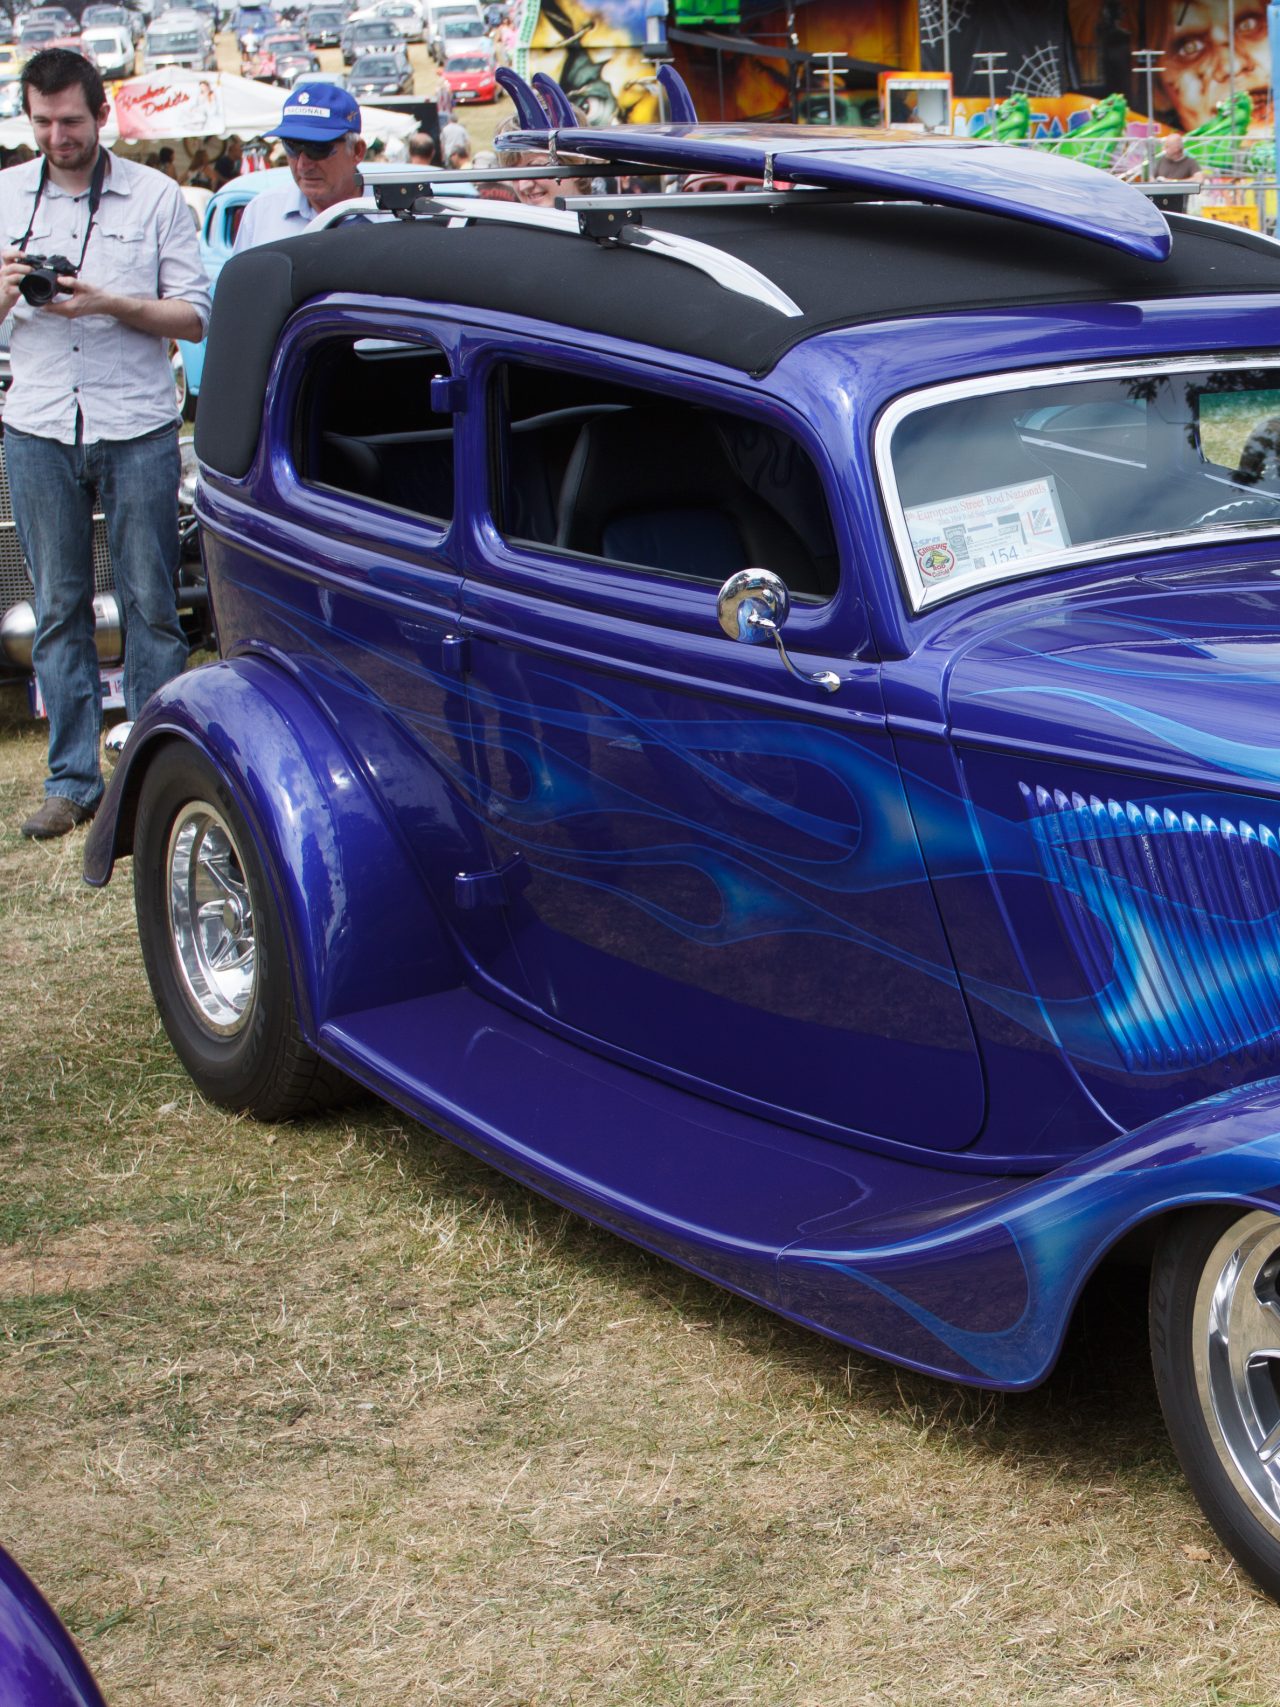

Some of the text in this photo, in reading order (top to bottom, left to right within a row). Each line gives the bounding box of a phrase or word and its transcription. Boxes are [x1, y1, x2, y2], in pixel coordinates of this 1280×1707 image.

[917, 504, 959, 521] European
[960, 498, 985, 511] Street
[986, 493, 1004, 506] Rod
[1005, 483, 1046, 501] Nationals
[990, 546, 1019, 565] 154
